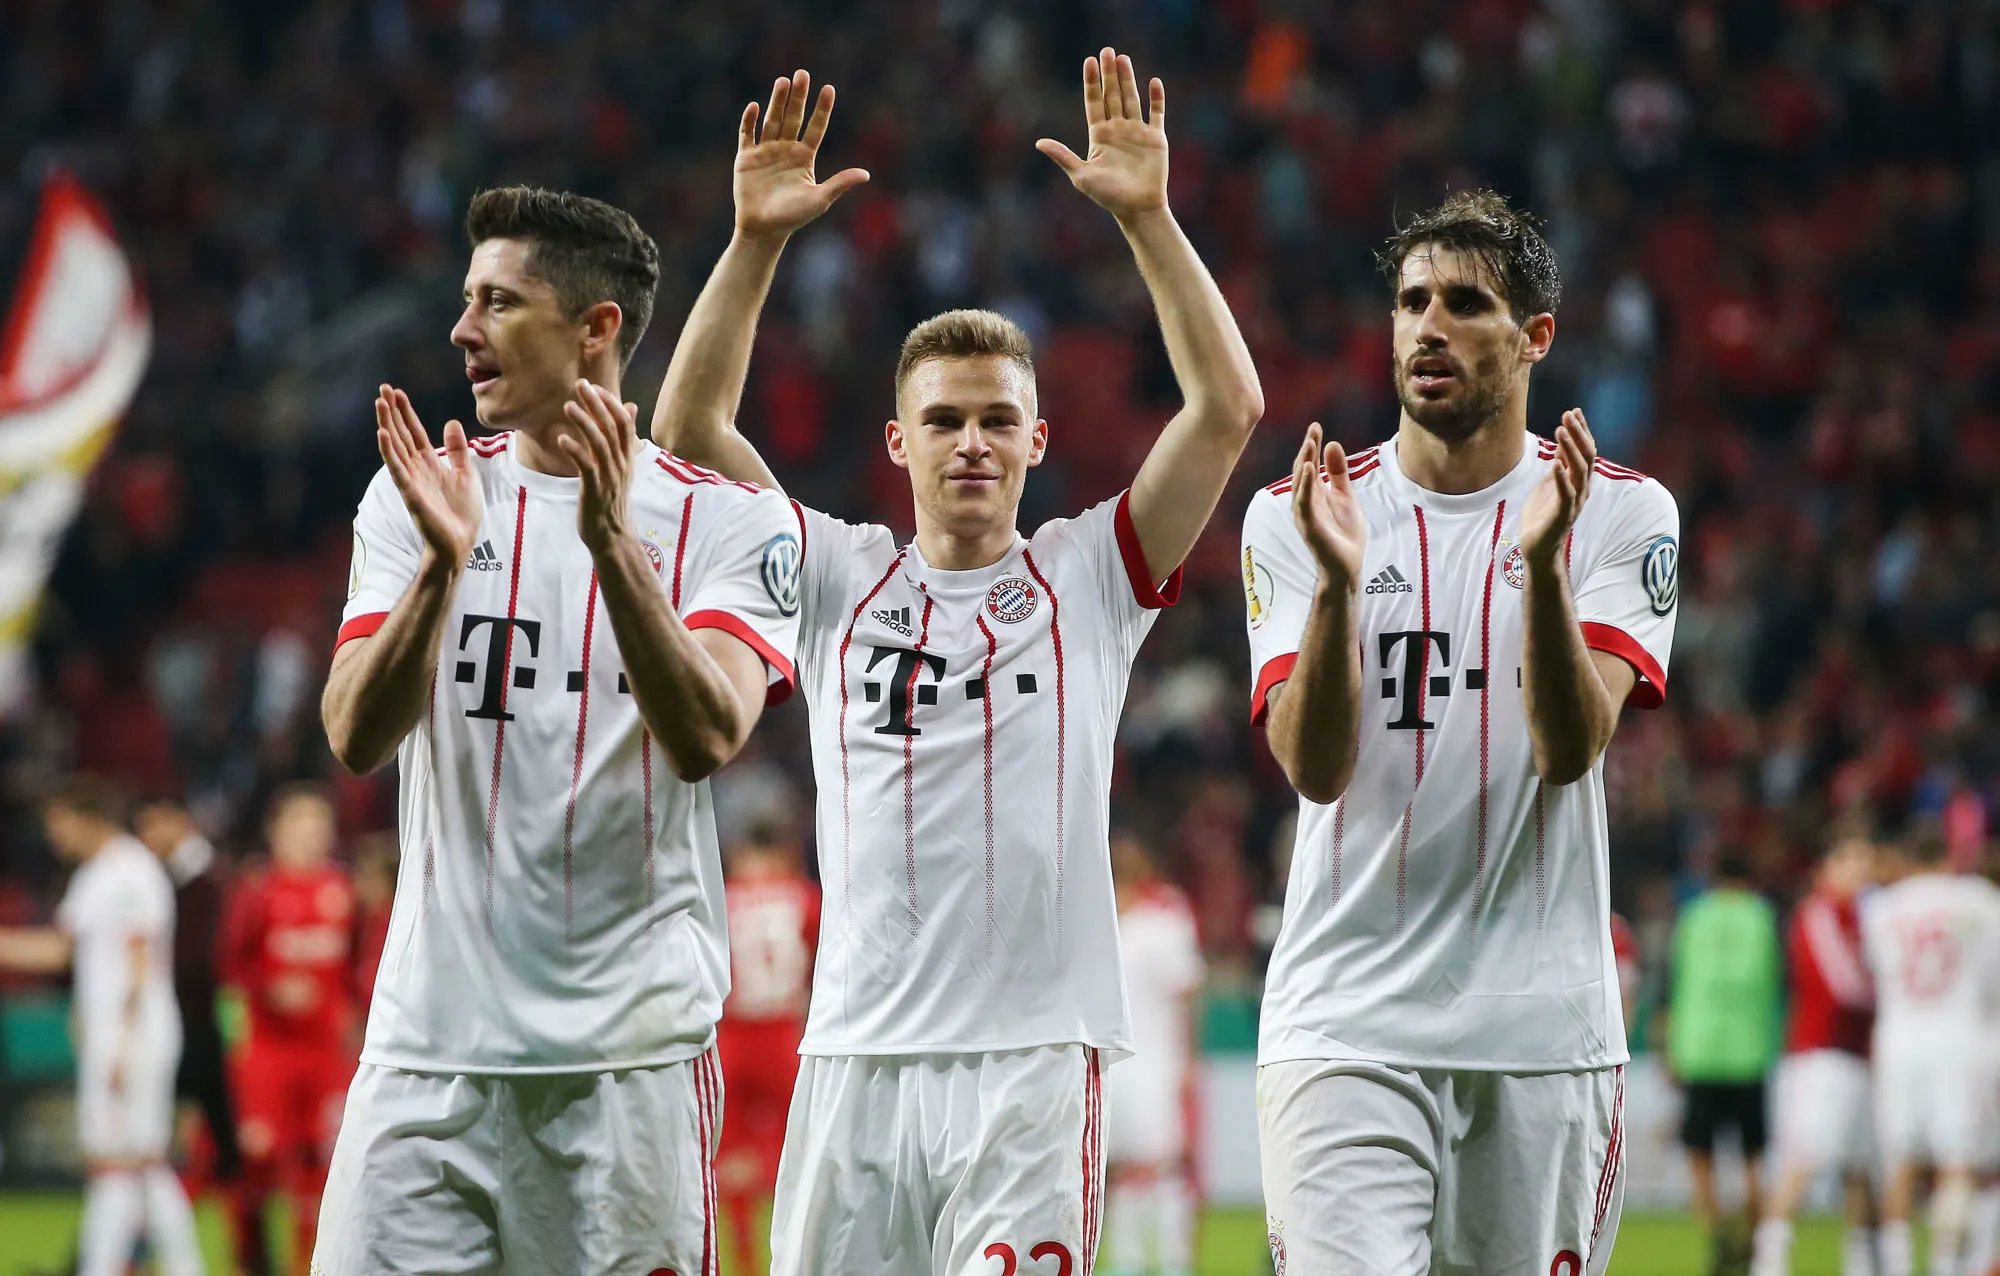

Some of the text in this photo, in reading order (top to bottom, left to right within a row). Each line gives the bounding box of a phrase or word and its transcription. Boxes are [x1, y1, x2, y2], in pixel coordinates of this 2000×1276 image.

[467, 558, 503, 571] didas
[989, 580, 1030, 605] FC BAYERN
[1365, 582, 1413, 595] adidas
[871, 610, 914, 638] adidas
[459, 614, 541, 721] T
[1379, 631, 1450, 730] T
[865, 646, 947, 736] T
